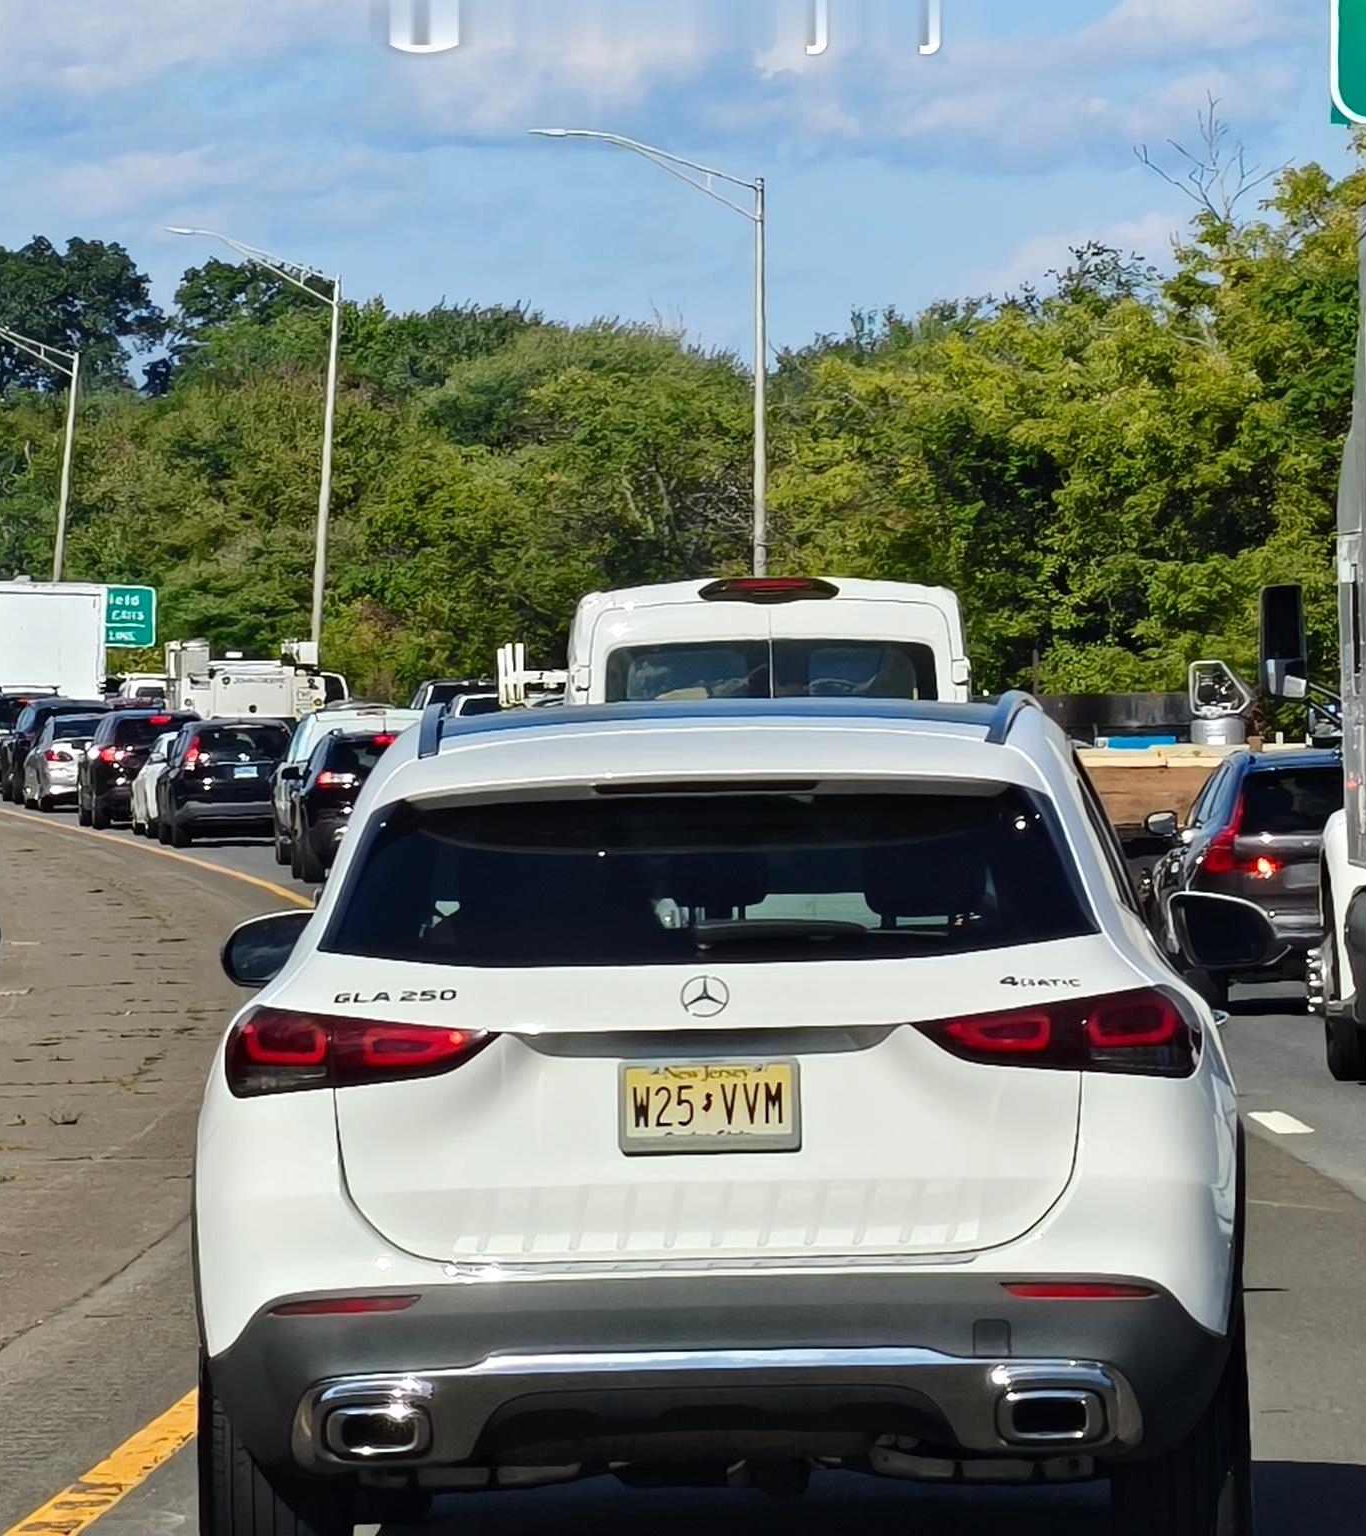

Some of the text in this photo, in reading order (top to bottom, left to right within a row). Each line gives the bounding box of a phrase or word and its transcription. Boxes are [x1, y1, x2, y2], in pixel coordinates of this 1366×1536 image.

[333, 989, 457, 1003] GLA 250
[720, 1081, 783, 1126] VVM
